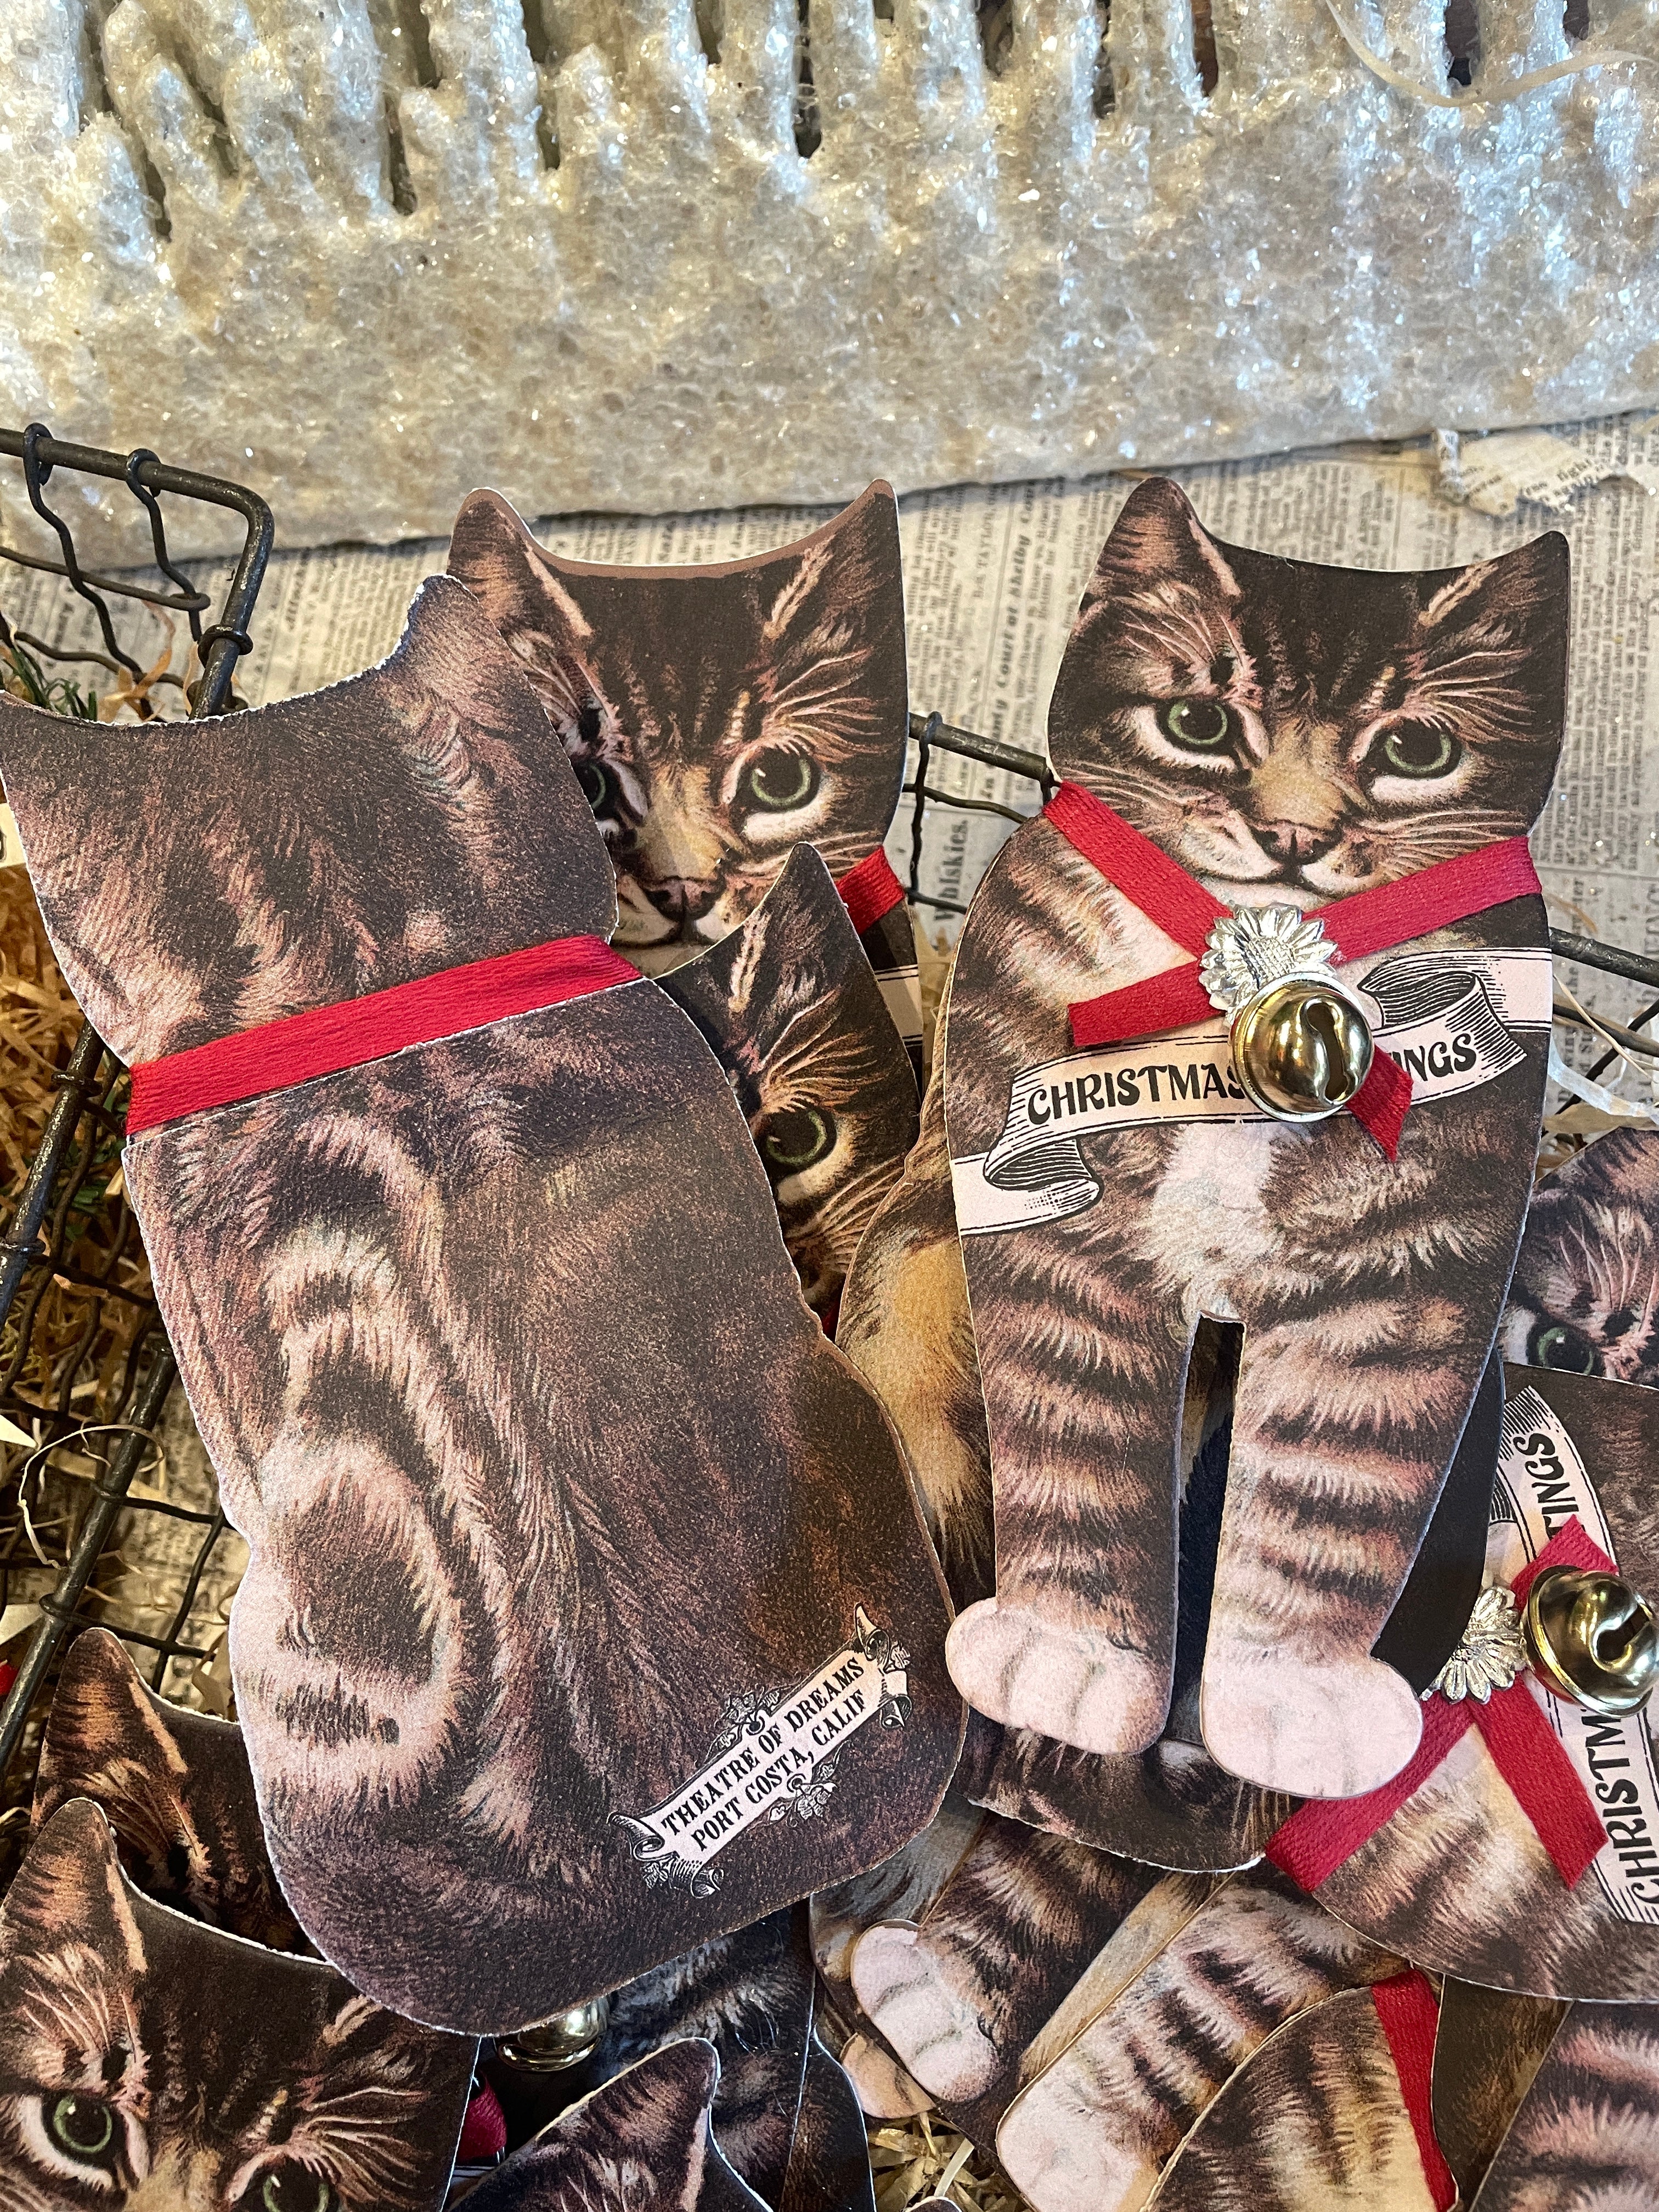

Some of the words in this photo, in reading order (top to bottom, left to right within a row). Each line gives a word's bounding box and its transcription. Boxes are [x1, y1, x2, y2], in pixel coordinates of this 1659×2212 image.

[661, 1747, 760, 1836] THEATRE
[758, 1724, 783, 1753] OF
[785, 1657, 866, 1732] DREAMS
[690, 1797, 743, 1851] PORT
[745, 1747, 814, 1803] COSTA,
[811, 1689, 866, 1746] CALIF
[1581, 1709, 1659, 1904] CHRISTM
